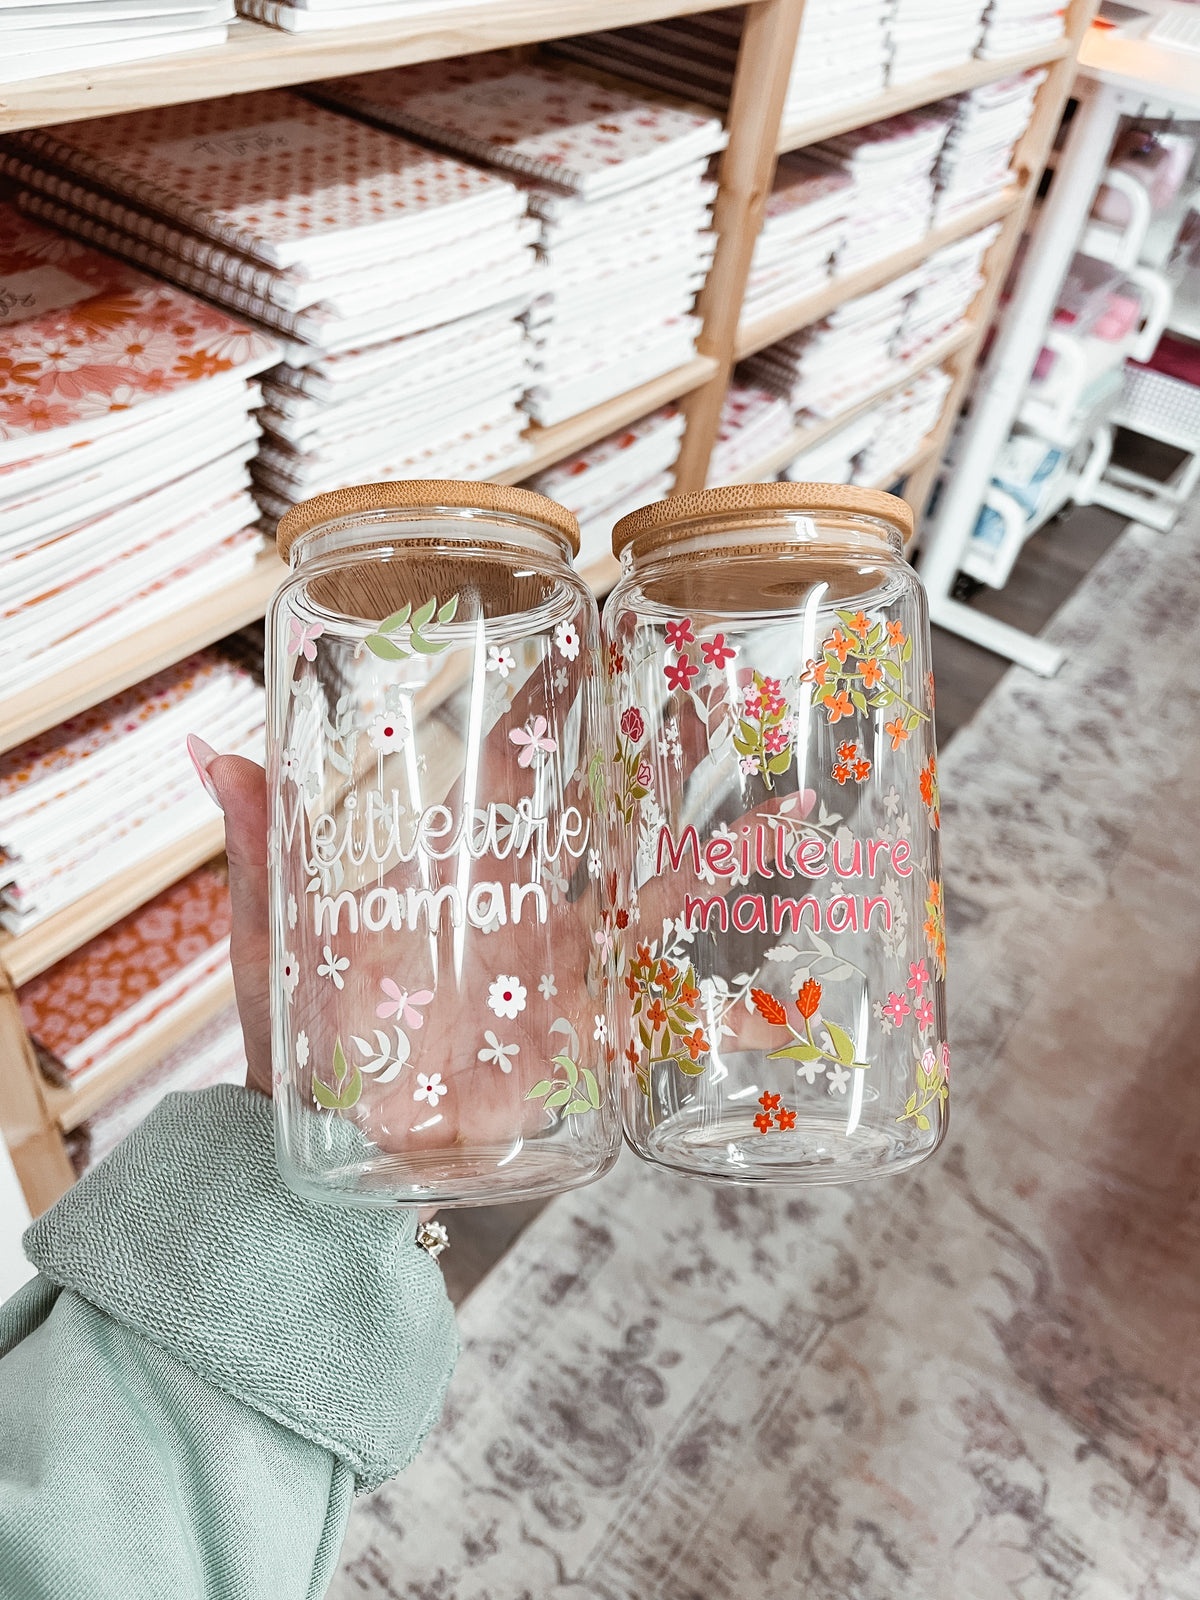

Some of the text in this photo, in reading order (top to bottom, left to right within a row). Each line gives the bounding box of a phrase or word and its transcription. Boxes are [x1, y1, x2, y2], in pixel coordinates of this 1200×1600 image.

[279, 784, 590, 876] Meilleure
[656, 824, 914, 880] Meilleure
[314, 881, 549, 936] maman
[684, 893, 893, 934] maman
